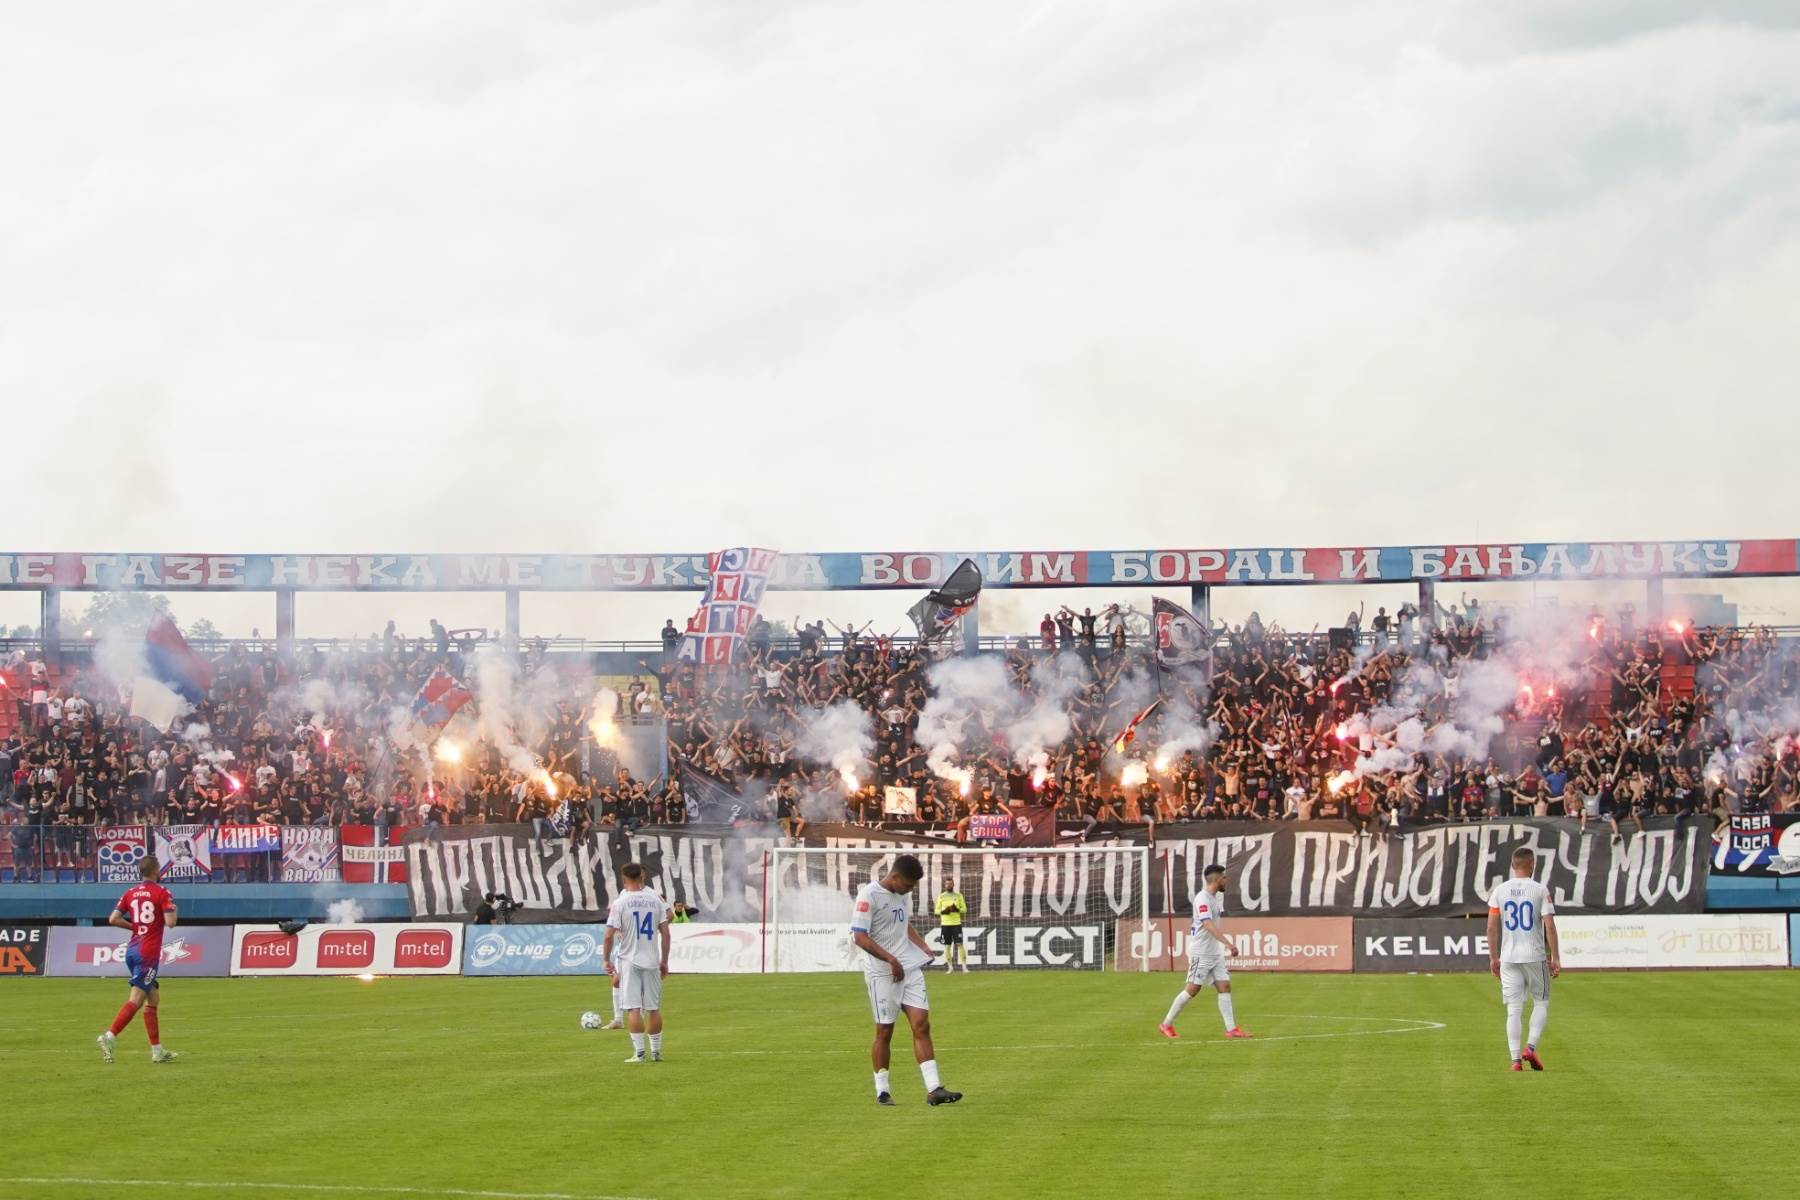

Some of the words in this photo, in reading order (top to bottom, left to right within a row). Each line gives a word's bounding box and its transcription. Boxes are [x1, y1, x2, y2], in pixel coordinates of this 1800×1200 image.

[82, 556, 246, 585] ГАЗЕ
[270, 556, 438, 585] НЕКА
[459, 556, 542, 586] МЕ
[1110, 550, 1315, 582] БОРАЦ
[1338, 549, 1382, 579] И
[1409, 542, 1742, 579] БАЊАЛУКУ
[1731, 815, 1771, 830] CASA
[282, 827, 334, 845] НОВА
[1733, 834, 1770, 850] LOCA
[102, 864, 141, 874] ПРОТИ
[284, 868, 337, 882] ВАРОШ
[1155, 831, 1275, 914] ТОГА
[1289, 824, 1593, 909] ПРИЈАТЕЉУ
[1605, 825, 1699, 907] МОЈ
[130, 898, 155, 924] 18
[892, 908, 905, 924] 70
[1504, 900, 1534, 932] 30
[632, 911, 654, 941] 14
[247, 941, 291, 956] m:tel
[323, 940, 368, 956] m:tel
[400, 940, 445, 956] m:tel
[504, 943, 554, 956] ELNOS
[924, 926, 1099, 966] SELECT
[1168, 929, 1279, 958] Jnta
[1280, 944, 1339, 958] SPORT
[1365, 935, 1489, 956] KELME
[1698, 931, 1782, 953] HOTEL
